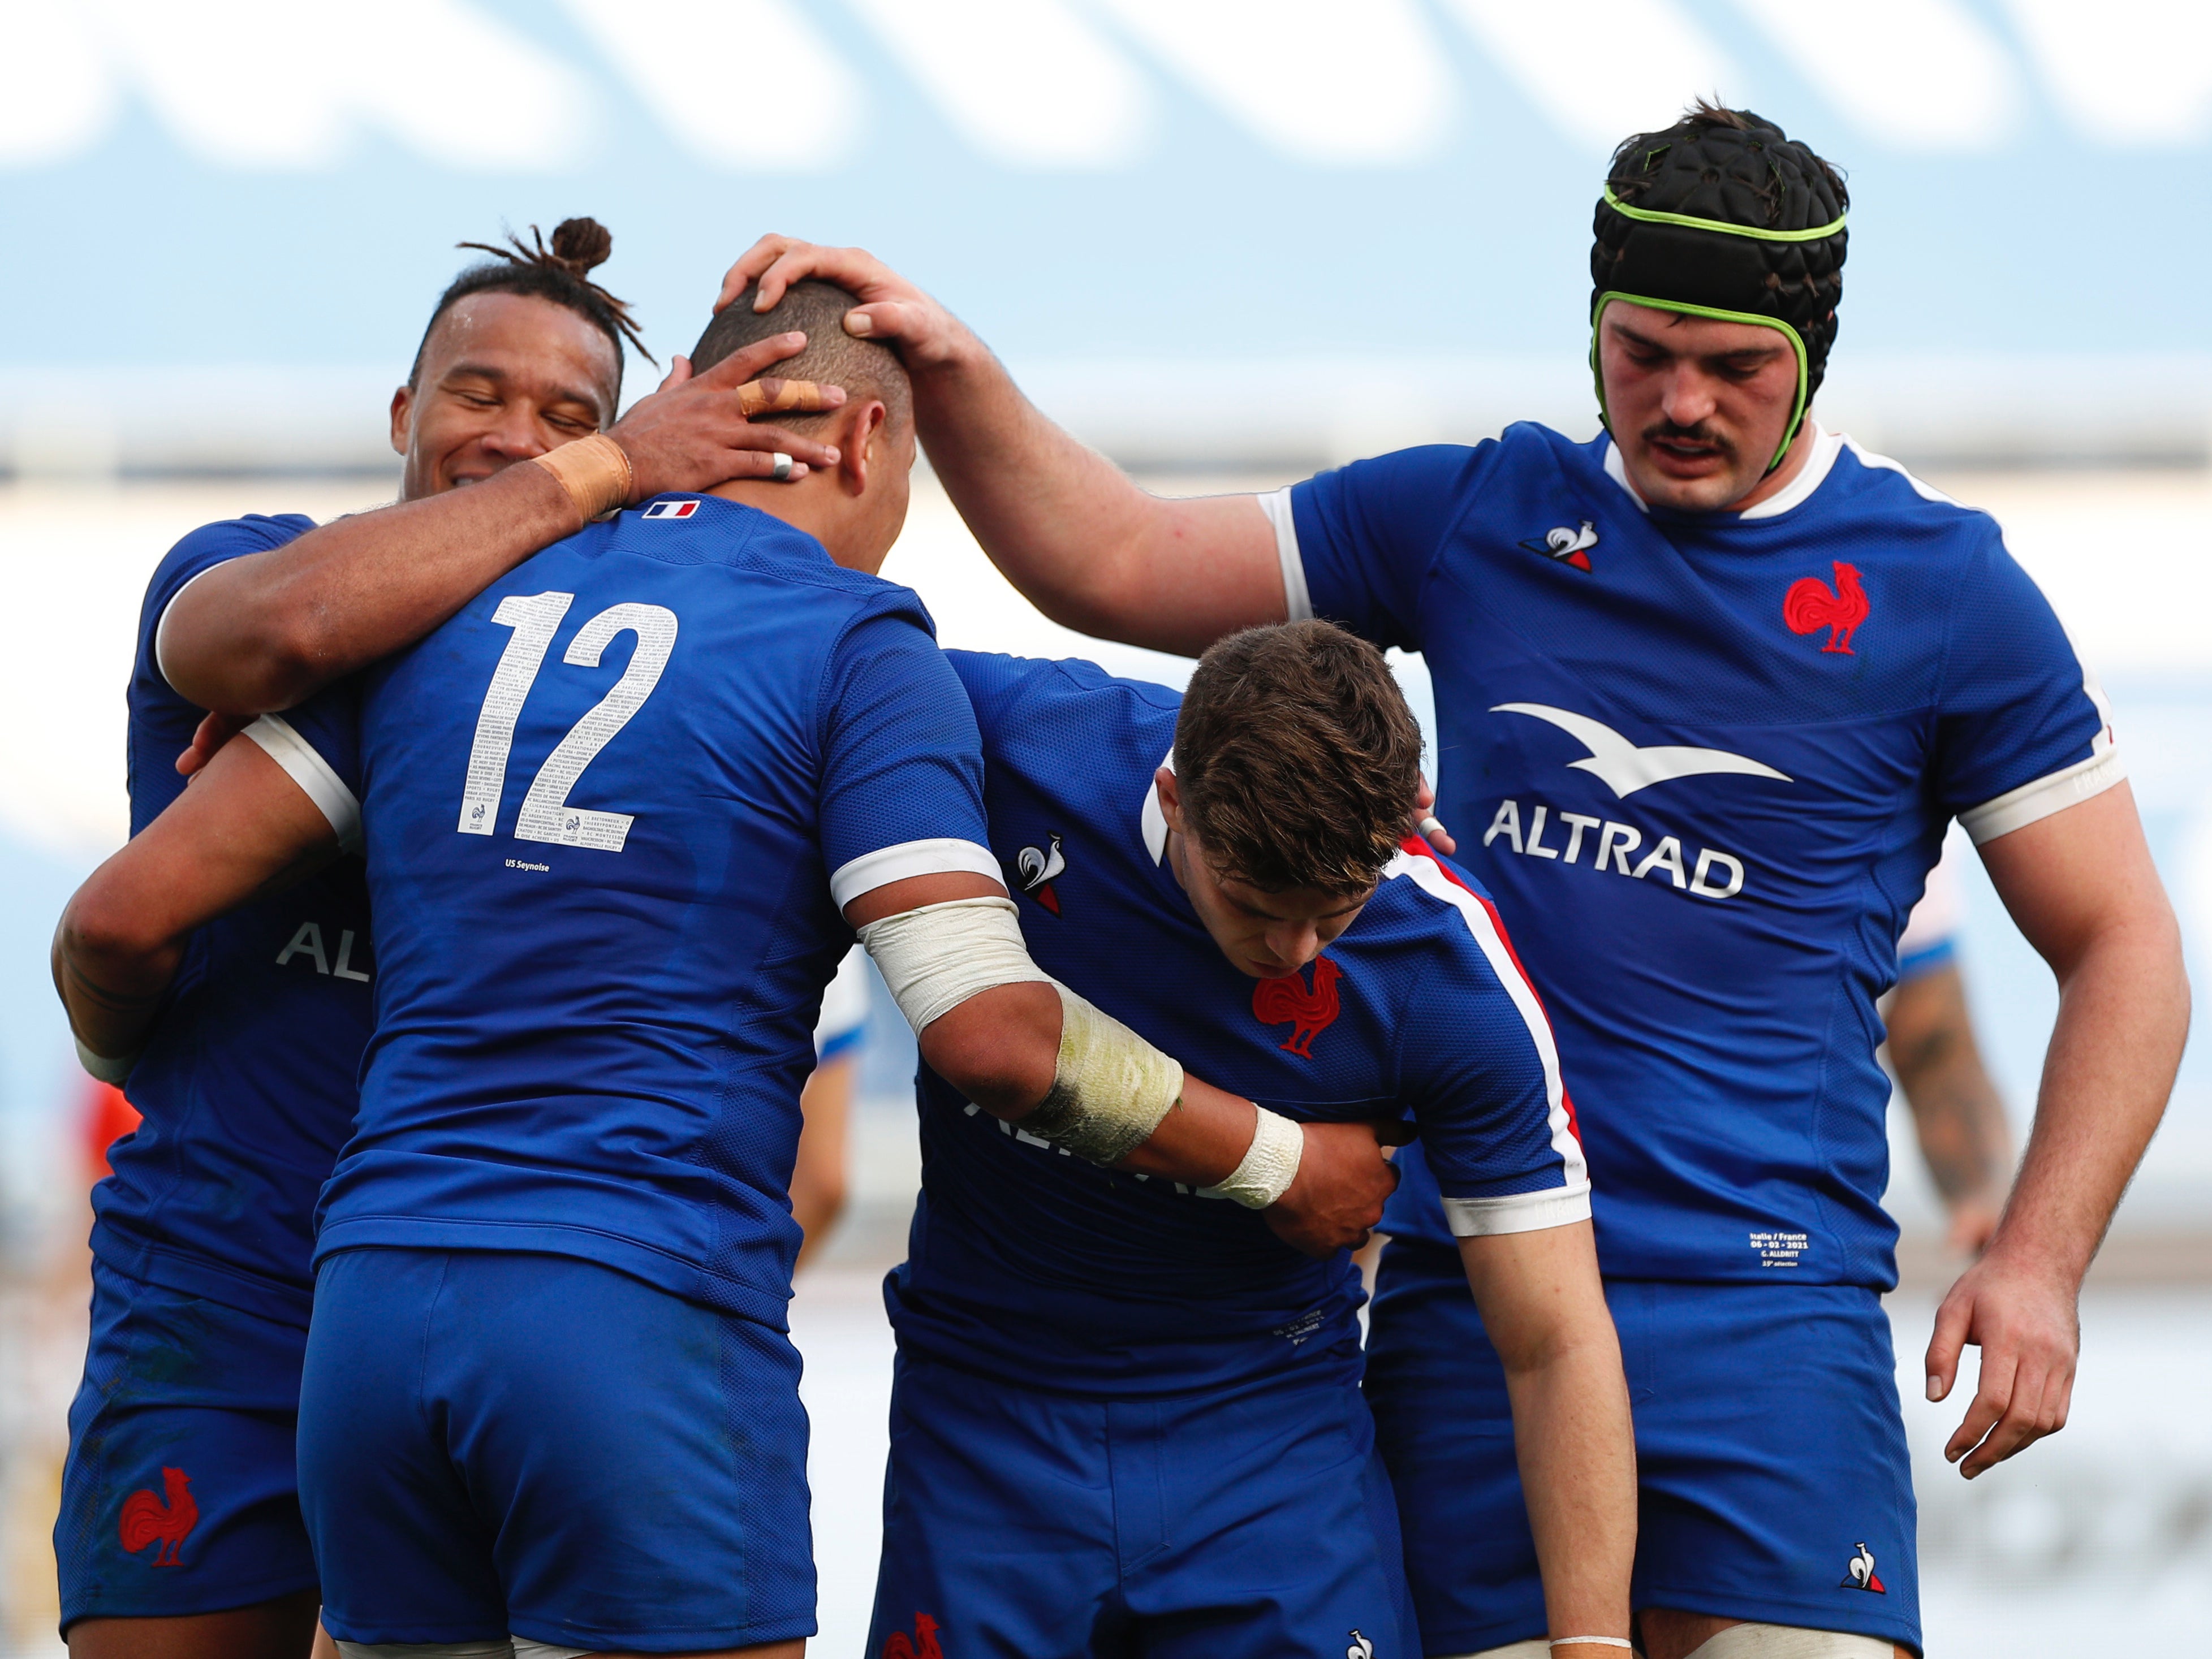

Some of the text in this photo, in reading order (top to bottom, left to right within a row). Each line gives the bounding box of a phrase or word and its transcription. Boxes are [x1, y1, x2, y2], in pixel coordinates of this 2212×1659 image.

[457, 591, 680, 853] 12
[516, 861, 549, 871] Seynoise
[1483, 800, 1745, 899] ALTRAD
[276, 922, 371, 982] AL
